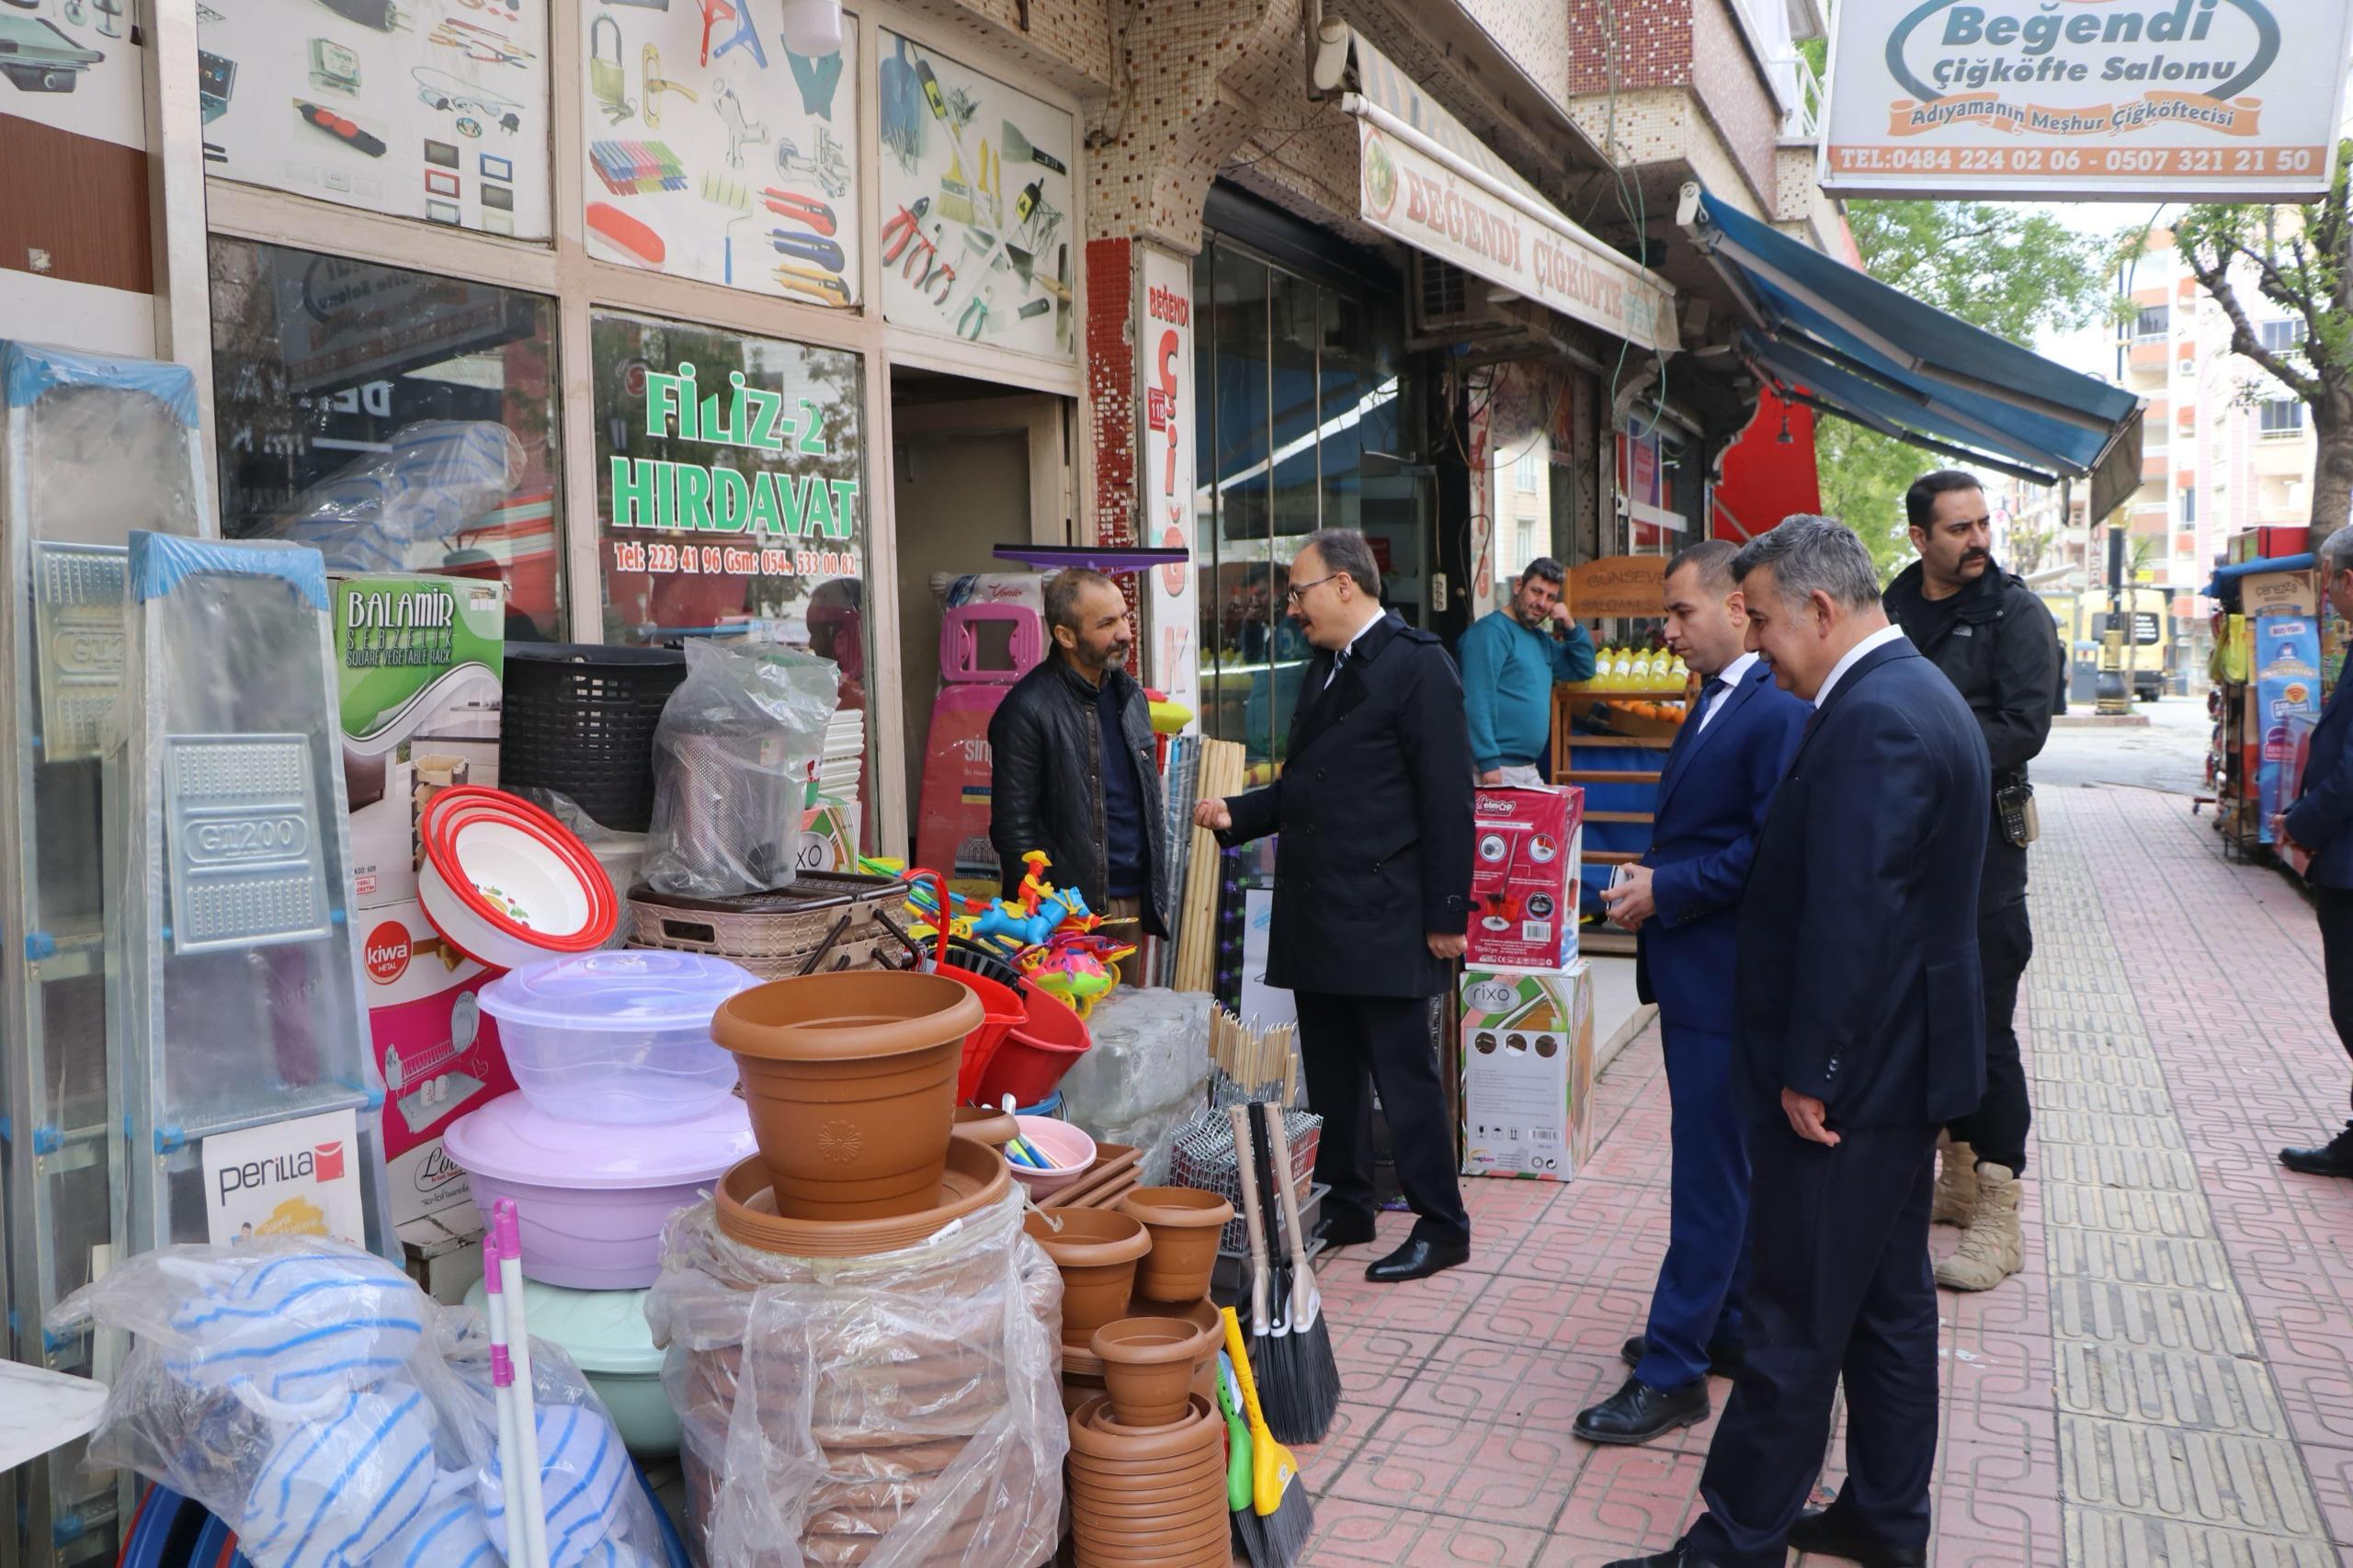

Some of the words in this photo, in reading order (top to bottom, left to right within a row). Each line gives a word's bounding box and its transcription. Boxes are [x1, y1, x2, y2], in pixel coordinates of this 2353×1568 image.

[1941, 0, 2218, 55] Beğendi
[1933, 56, 2088, 89] Çiğköfte
[2100, 55, 2237, 81] Salonu
[1911, 99, 2025, 126] Adıyamanın
[2031, 110, 2105, 135] Meşhur
[2111, 99, 2234, 131] Çiğköftecisi
[1839, 148, 1951, 170] TEL:0484
[1959, 149, 2005, 170] 224
[2011, 149, 2042, 170] 02
[2050, 149, 2081, 170] 06
[2106, 149, 2169, 171] 0507
[2177, 149, 2223, 171] 321
[2234, 149, 2265, 171] 21
[2276, 149, 2311, 171] 50
[1404, 166, 1523, 274] BEĞENDİ
[644, 361, 827, 457] FİLİZ-2
[609, 456, 858, 540] HIRDAVAT
[648, 544, 677, 573] 223
[680, 546, 699, 574] 41
[702, 546, 722, 574] 96
[724, 547, 759, 575] Gsm:
[796, 551, 819, 576] 533
[823, 552, 838, 576] 00
[840, 552, 856, 576] 82
[347, 649, 380, 666] SQUARE
[382, 648, 426, 665] VEGETABLE
[368, 942, 408, 965] kiwa
[378, 962, 396, 972] METAL
[1473, 984, 1510, 1002] rixo
[220, 1151, 313, 1207] perilla
